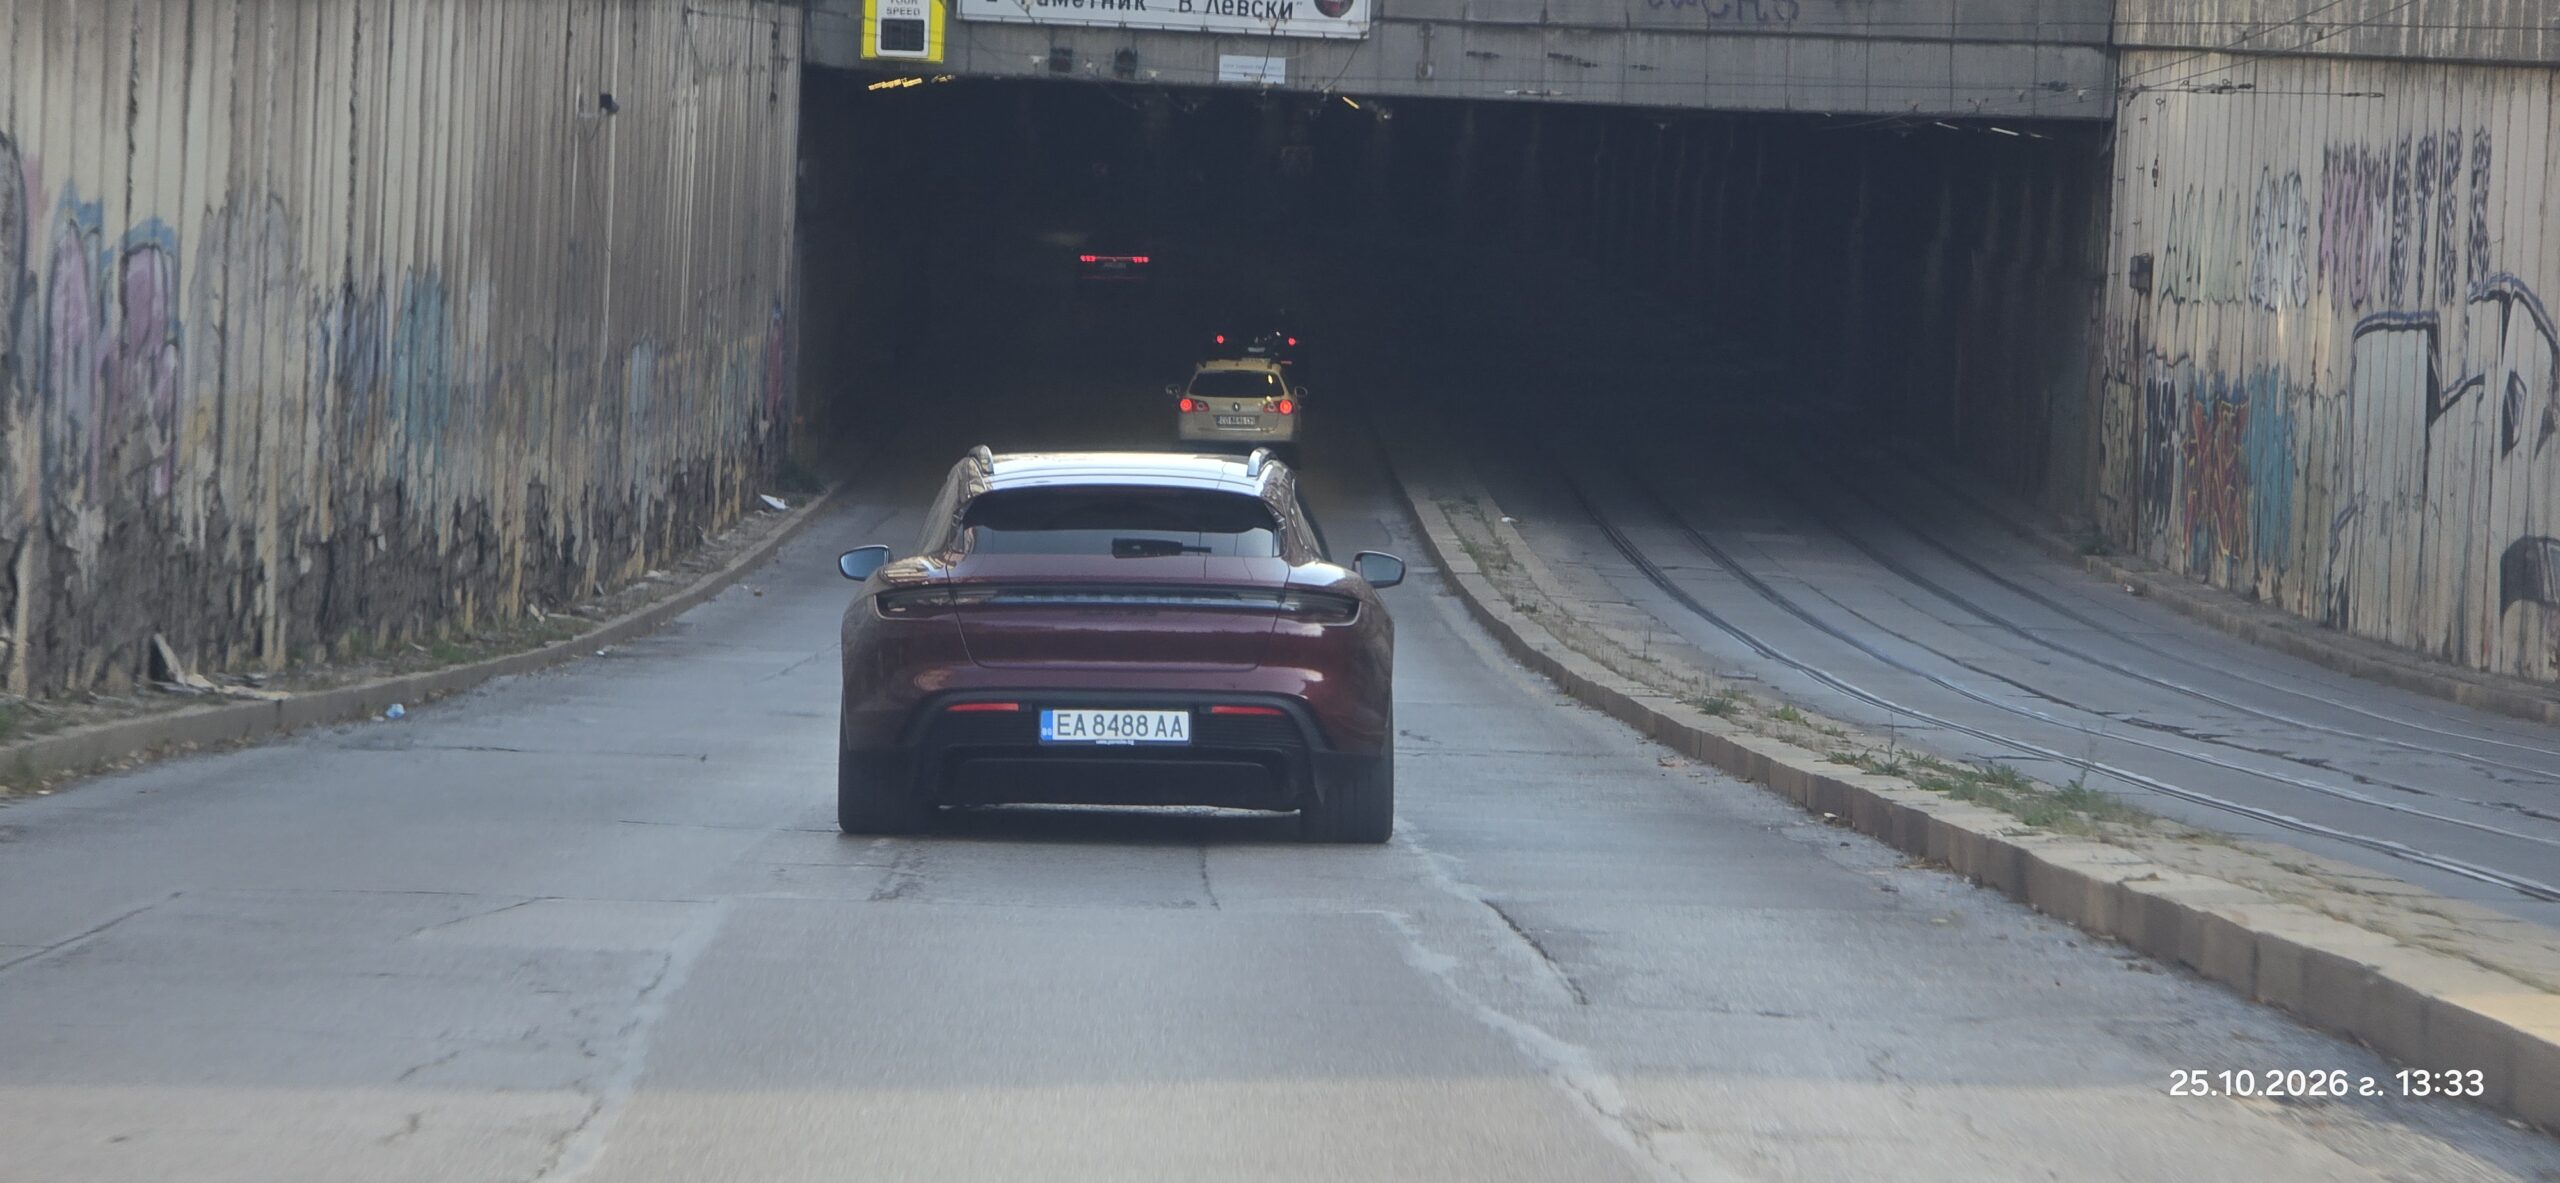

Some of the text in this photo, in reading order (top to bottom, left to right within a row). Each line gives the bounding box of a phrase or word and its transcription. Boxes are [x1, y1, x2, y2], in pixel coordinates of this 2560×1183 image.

[886, 6, 920, 16] SPEED
[1057, 713, 1183, 738] EA 8488 AA
